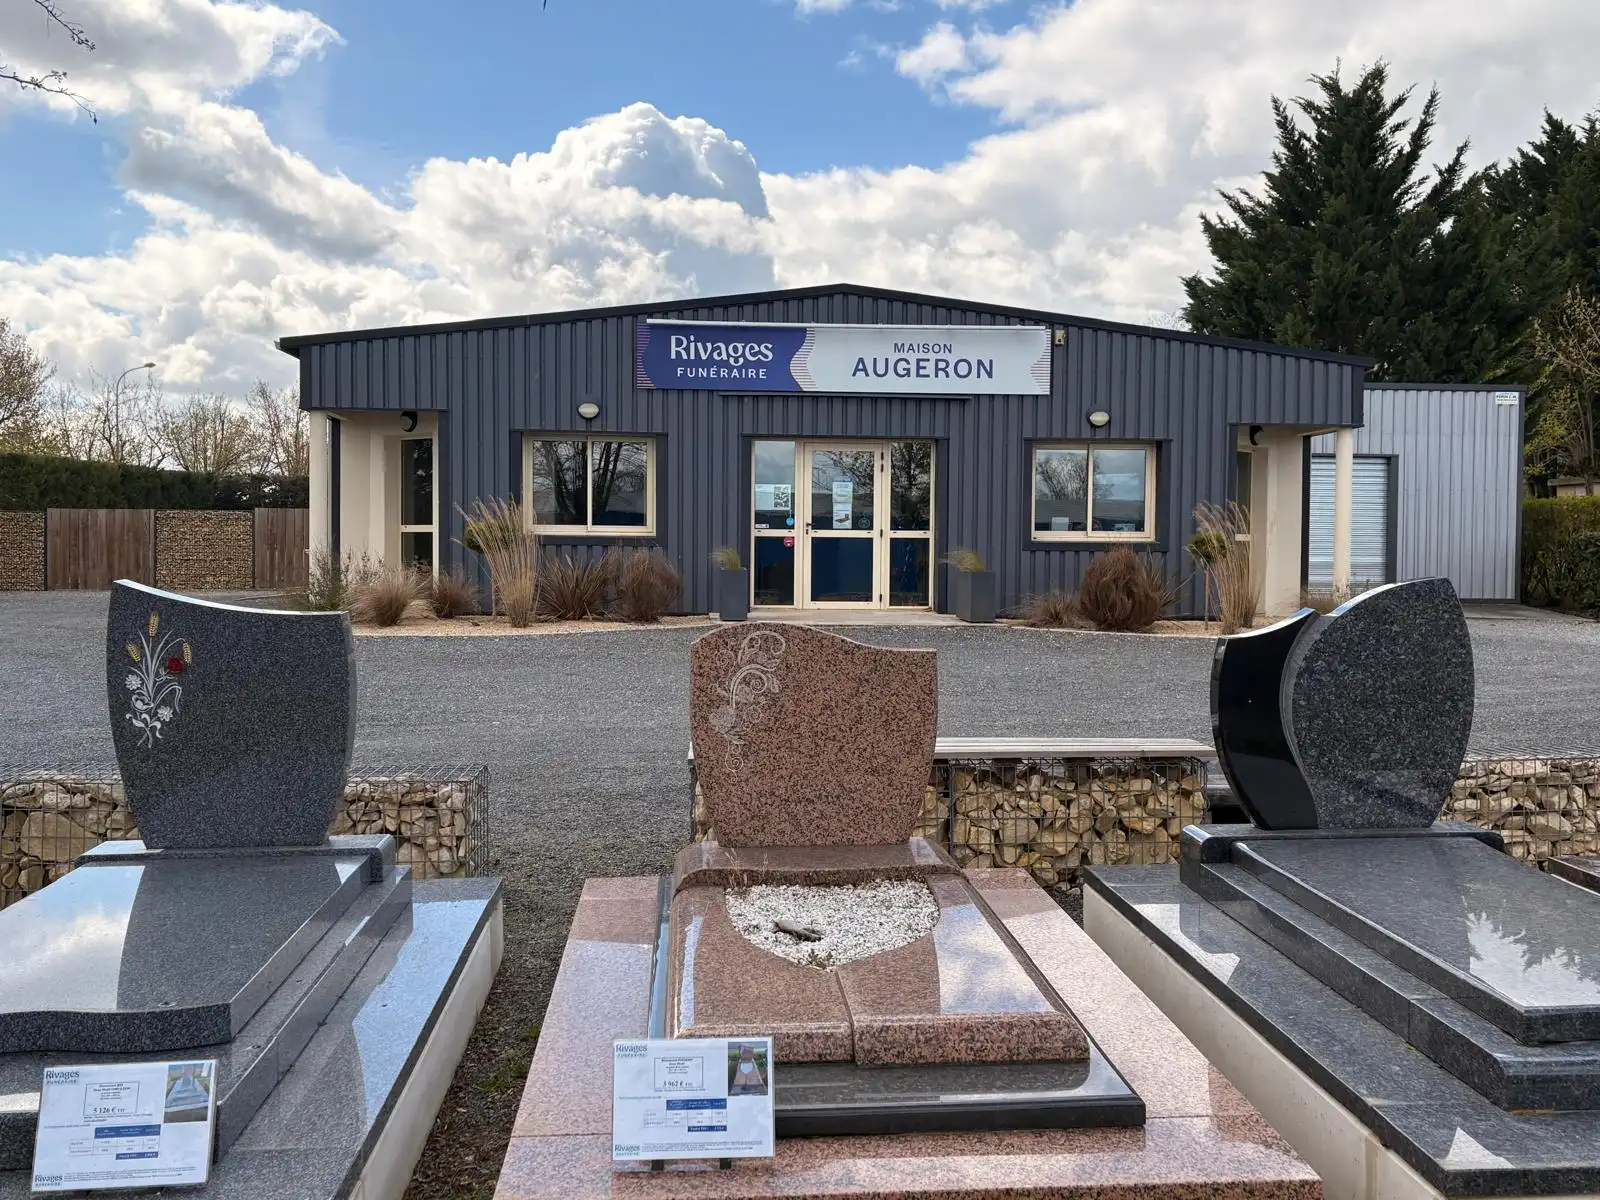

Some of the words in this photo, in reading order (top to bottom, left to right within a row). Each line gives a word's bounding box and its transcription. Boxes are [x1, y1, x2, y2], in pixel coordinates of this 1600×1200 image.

[670, 335, 774, 366] Rivages
[893, 342, 953, 354] MAISON
[677, 365, 768, 379] FUNÉRAIRE
[852, 357, 995, 379] AUGERON
[615, 1044, 648, 1054] Rivages
[45, 1070, 80, 1080] Rivages
[614, 1144, 640, 1152] Rivages
[34, 1174, 63, 1183] Rivages
